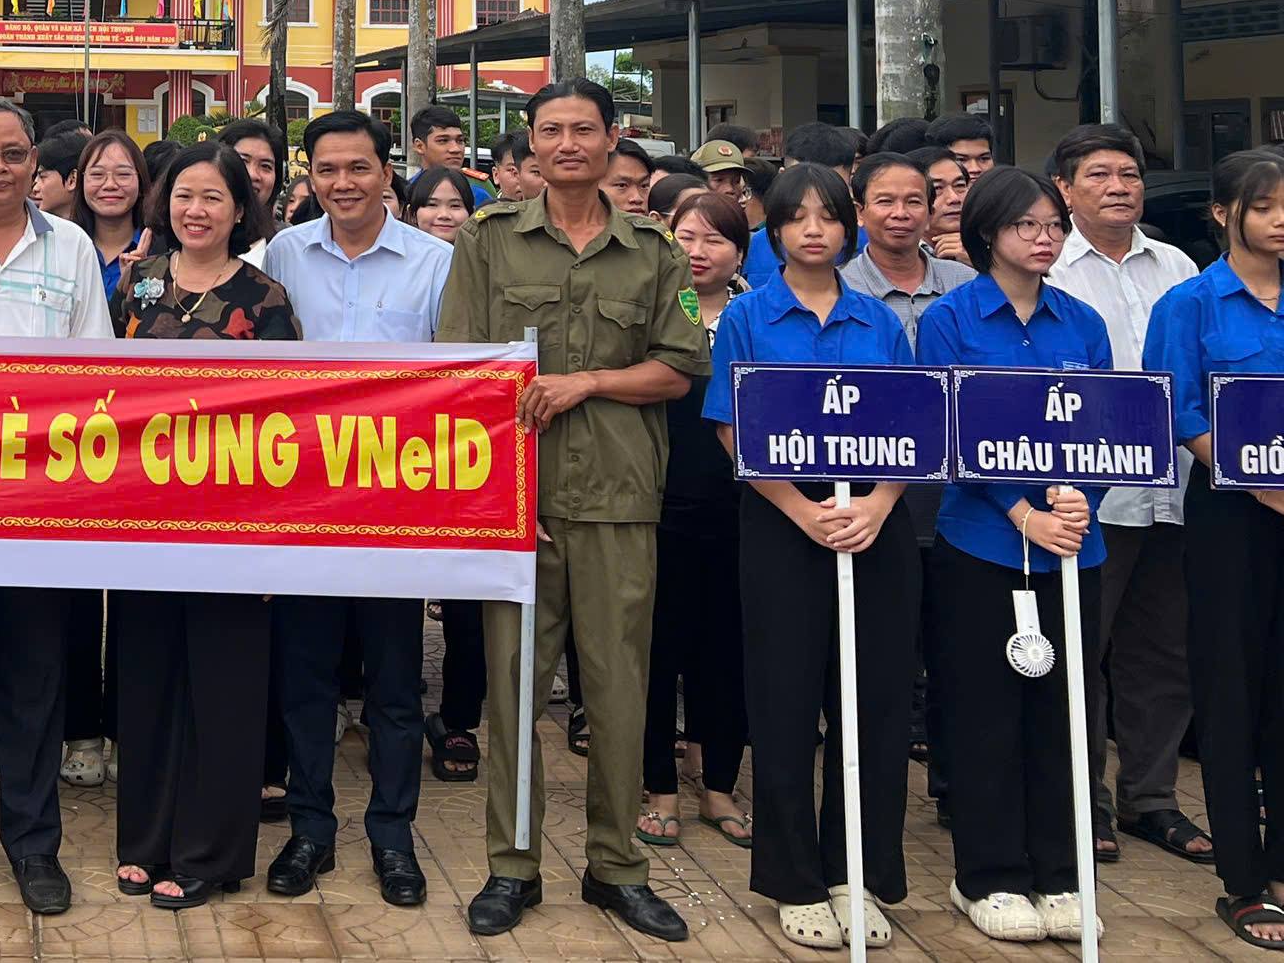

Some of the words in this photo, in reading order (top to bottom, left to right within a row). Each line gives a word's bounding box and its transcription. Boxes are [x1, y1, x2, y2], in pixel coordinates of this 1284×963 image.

[822, 375, 860, 414] ẤP
[1045, 382, 1082, 422] ẤP
[45, 389, 119, 484] SỐ
[140, 397, 299, 487] CÙNG
[316, 413, 492, 491] VNeID
[769, 429, 815, 471] HỘI
[823, 435, 916, 467] TRUNG
[977, 436, 1054, 472] CHÂU
[1061, 438, 1154, 475] THÀNH
